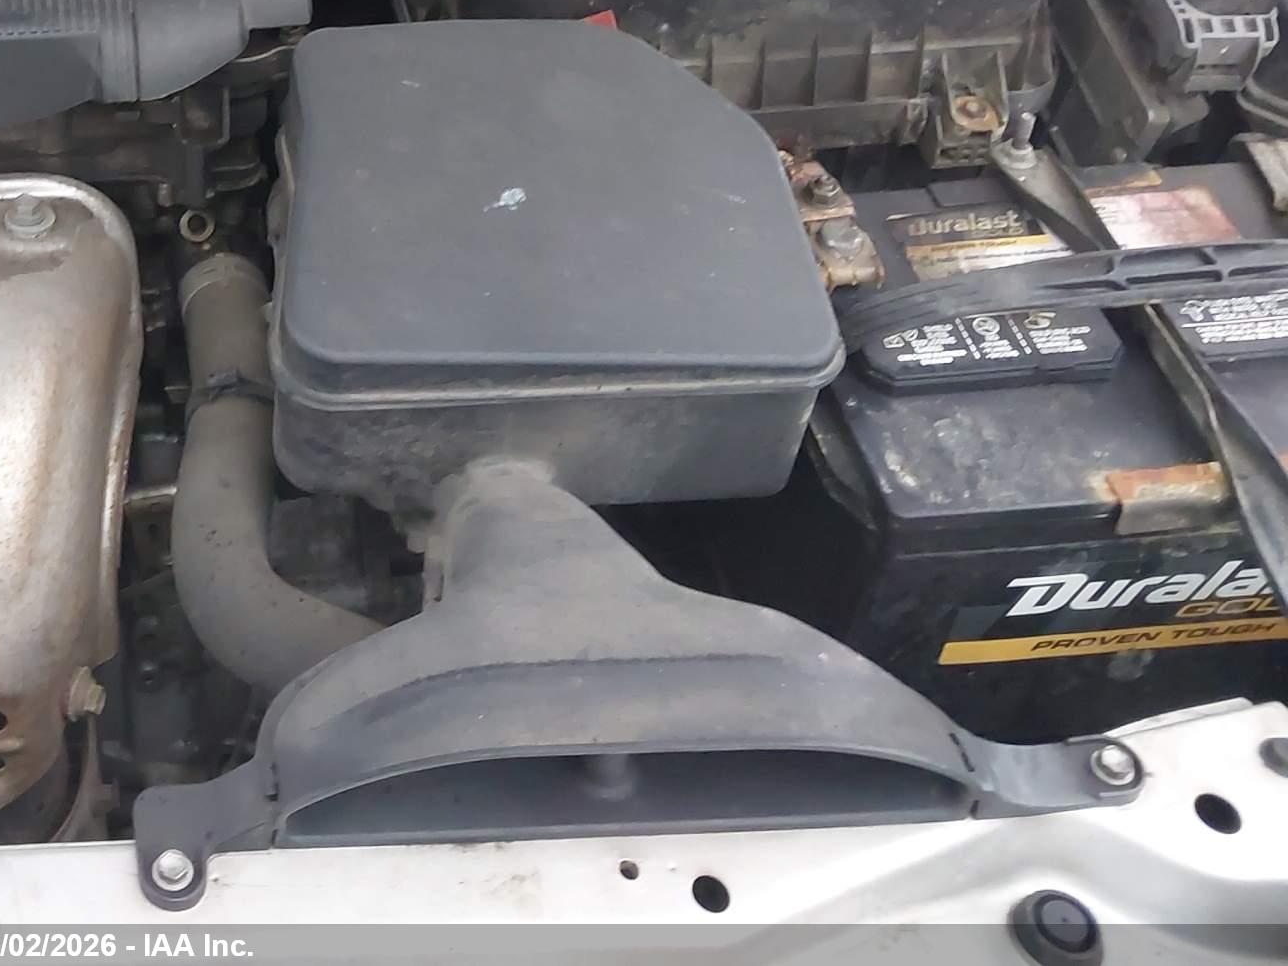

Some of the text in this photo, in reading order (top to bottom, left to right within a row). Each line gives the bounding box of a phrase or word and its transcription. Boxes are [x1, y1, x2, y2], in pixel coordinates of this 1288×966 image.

[1006, 560, 1274, 617] Durala
[1175, 597, 1281, 618] GOL
[1030, 622, 1278, 652] PROVEN TOUGH
